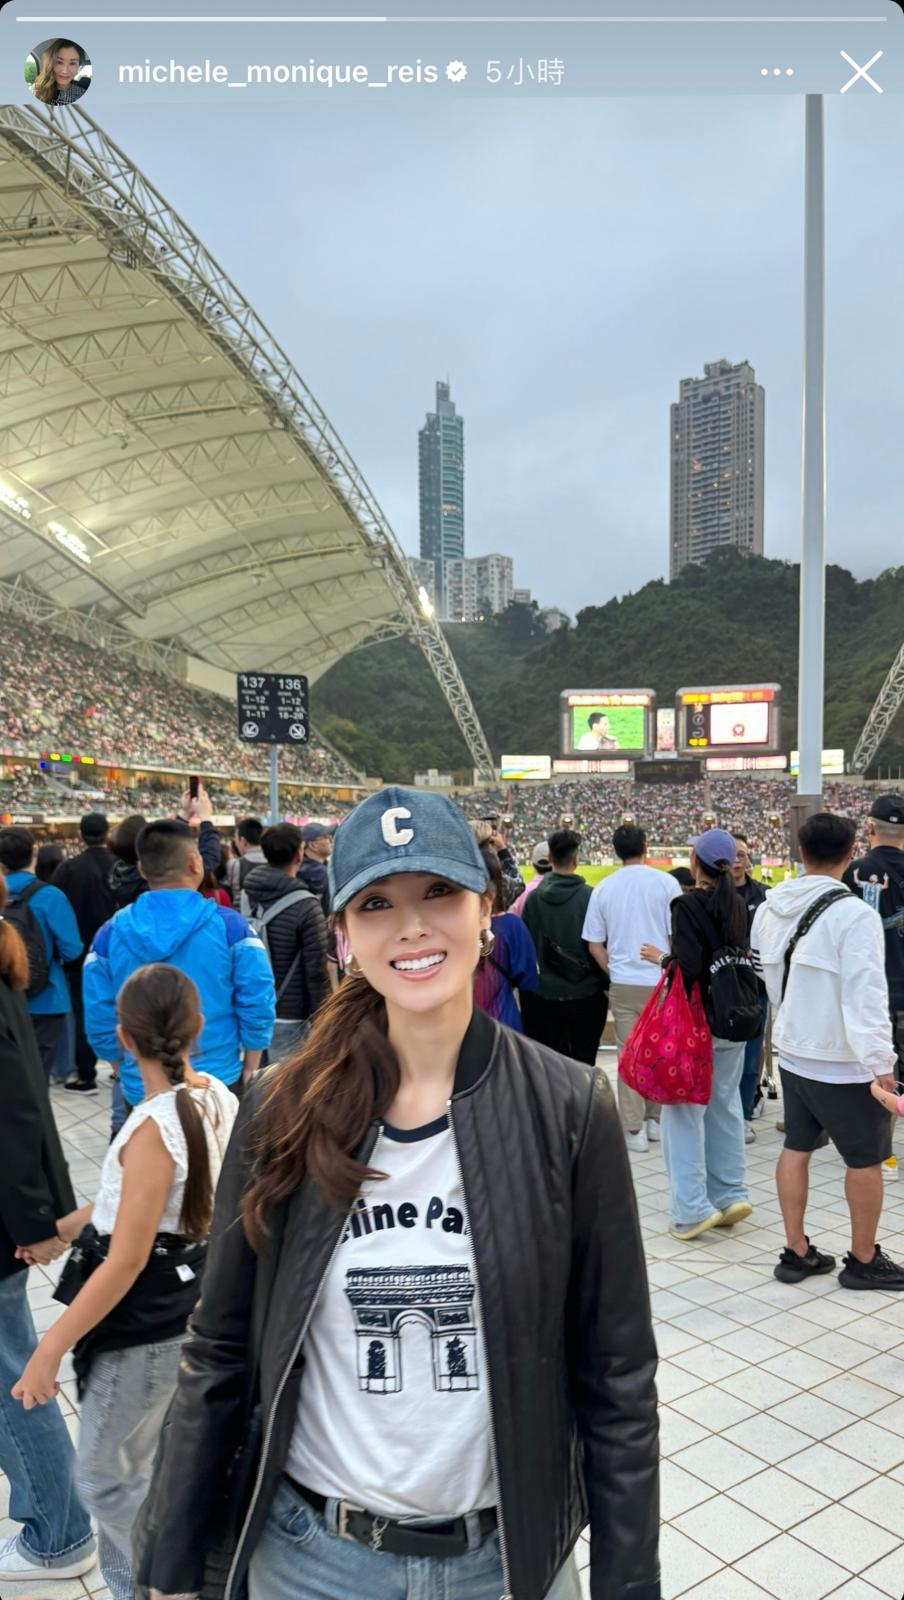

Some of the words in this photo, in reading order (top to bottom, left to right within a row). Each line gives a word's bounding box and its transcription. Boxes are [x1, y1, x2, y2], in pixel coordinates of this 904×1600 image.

[240, 675, 265, 688] 137
[278, 679, 301, 691] 136
[244, 696, 266, 704] 1-12
[281, 697, 302, 705] 1-12
[381, 807, 414, 847] C
[342, 1198, 418, 1244] line
[426, 1196, 470, 1236] Pa
